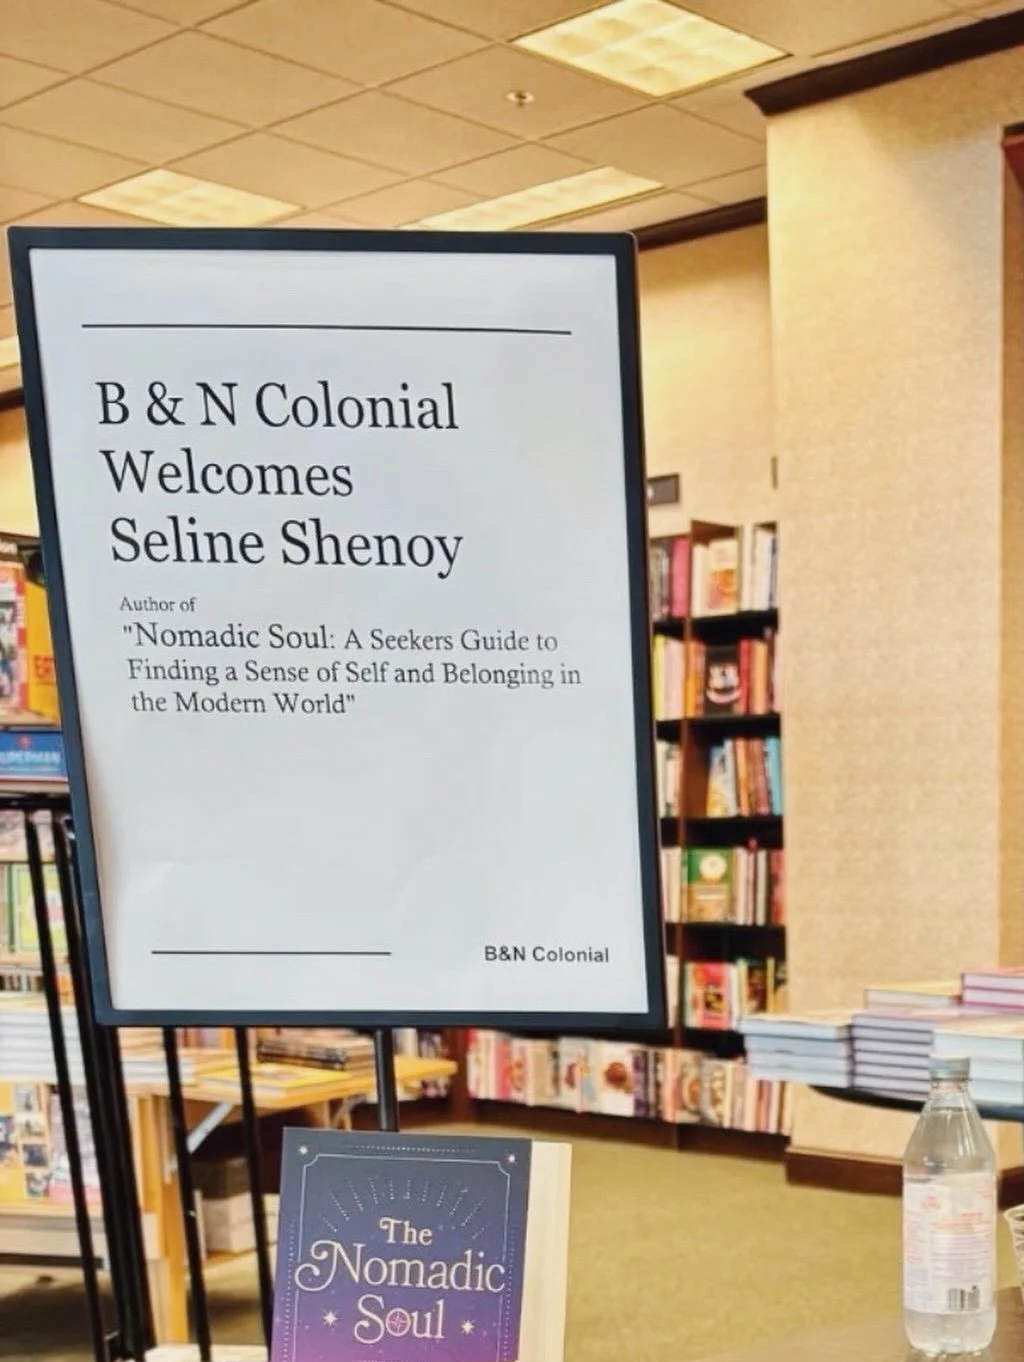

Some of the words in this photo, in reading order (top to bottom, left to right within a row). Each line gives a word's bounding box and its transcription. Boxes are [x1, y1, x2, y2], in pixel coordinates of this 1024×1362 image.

[95, 381, 130, 426] B
[146, 380, 186, 427] &
[196, 381, 239, 427] N
[255, 379, 460, 431] Colonial
[99, 447, 354, 497] Welcomes
[110, 514, 266, 564] Seline
[280, 517, 464, 580] Shenoy
[119, 595, 176, 613] Author
[179, 595, 197, 613] of
[123, 620, 260, 650] "Nomadic
[268, 622, 335, 651] Soul:
[343, 631, 363, 652] A
[370, 629, 454, 652] Seekers
[460, 629, 529, 653] Guide
[535, 632, 559, 653] to
[128, 657, 220, 687] Finding
[225, 665, 239, 682] a
[244, 660, 311, 684] Sense
[316, 659, 340, 684] of
[346, 660, 390, 684] Self
[393, 662, 436, 685] and
[442, 662, 555, 689] Belonging
[560, 664, 582, 686] in
[131, 691, 168, 713] the
[175, 691, 267, 715] Modern
[272, 692, 356, 715] World"
[483, 944, 527, 964] B&N
[532, 945, 610, 966] Colonial
[379, 1216, 433, 1246] The
[294, 1239, 506, 1293] Nomadic
[354, 1293, 445, 1345] Soul
